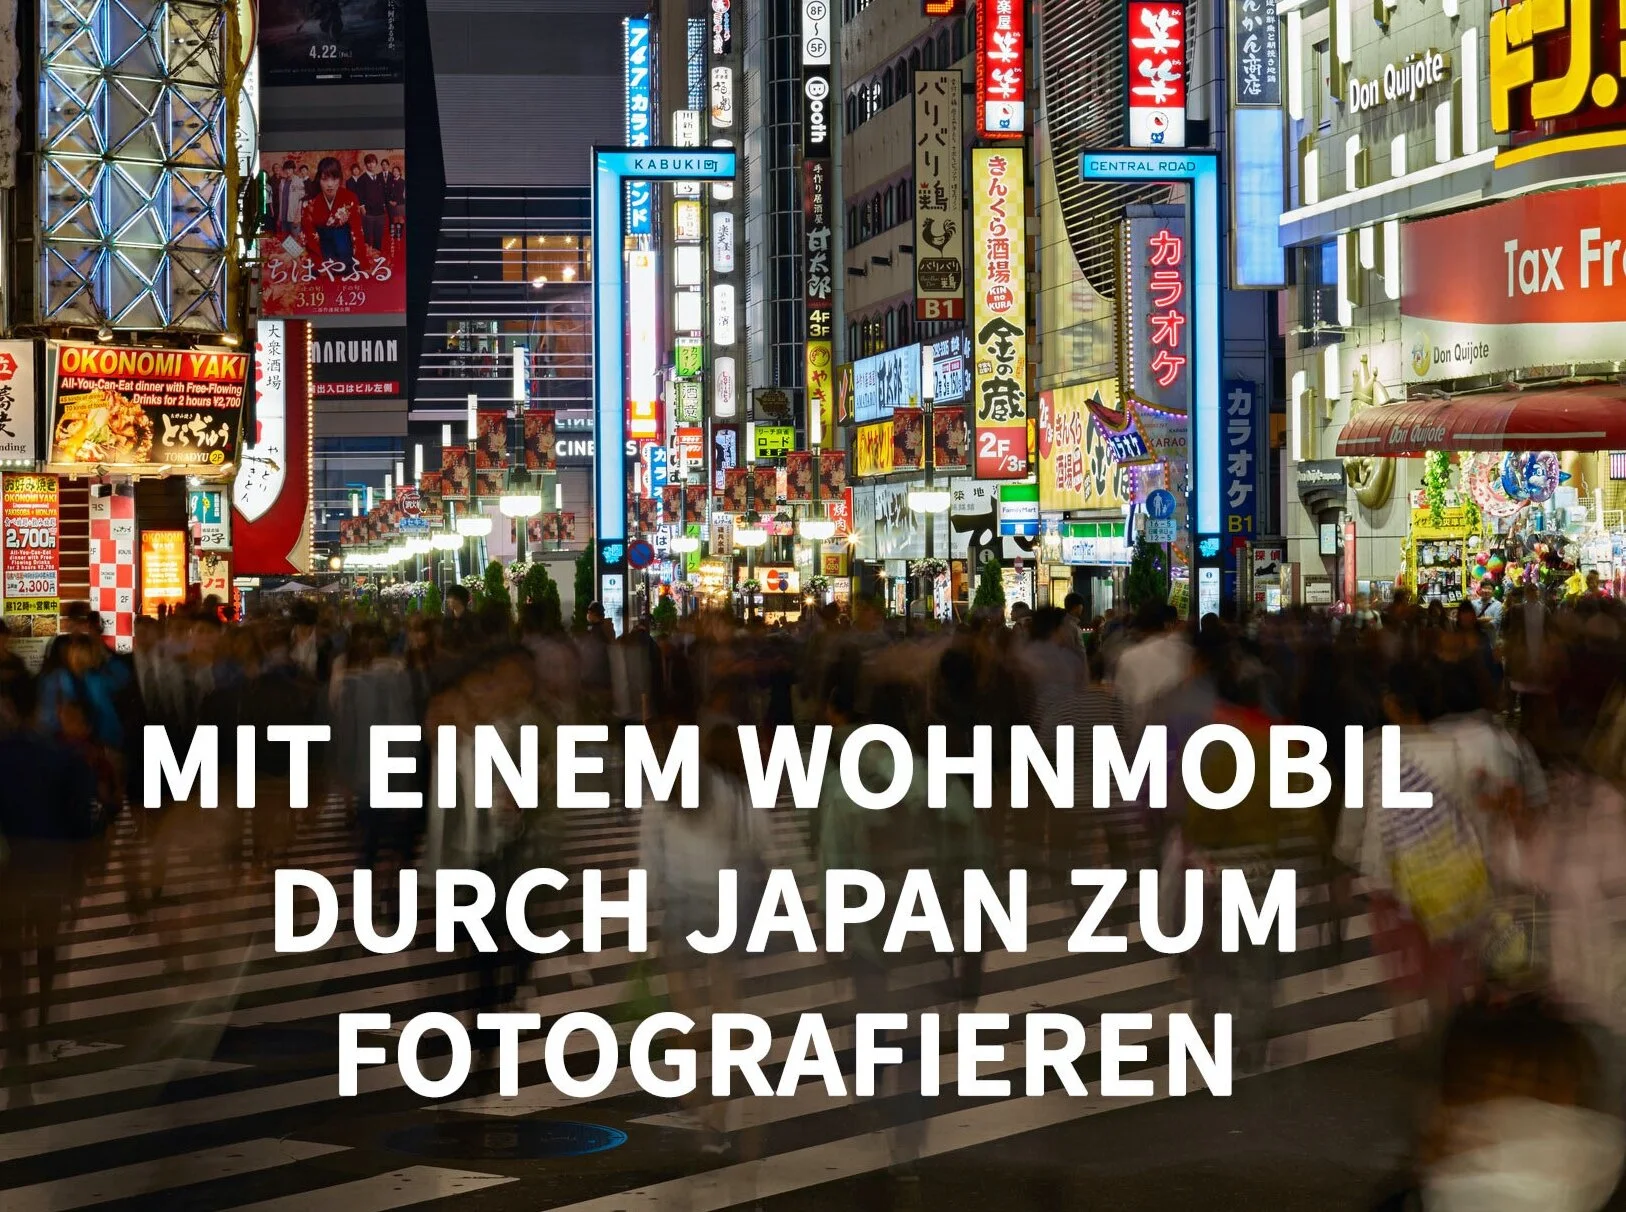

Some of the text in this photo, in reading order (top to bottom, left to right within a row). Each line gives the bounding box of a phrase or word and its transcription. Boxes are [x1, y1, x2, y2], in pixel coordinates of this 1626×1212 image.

[811, 6, 823, 15] 8F
[309, 45, 337, 59] 4.22
[630, 27, 649, 87] 747
[811, 43, 823, 53] 5F
[1132, 8, 1181, 104] 笑笑
[987, 31, 1020, 99] 笑笑
[1350, 49, 1443, 114] Don Quijote
[631, 94, 649, 228] カラオンド
[1090, 161, 1196, 171] CENTRAL ROAD
[987, 156, 1010, 284] きんくら酒場
[268, 257, 391, 283] ちはやふる
[806, 226, 832, 299] 甘太郎
[1504, 227, 1626, 297] Tax Fr
[297, 292, 366, 307] 3.19 4.29
[926, 300, 953, 318] B1
[989, 301, 1011, 309] KURA
[1150, 230, 1185, 386] カラオケ
[809, 309, 830, 322] 4F
[809, 324, 830, 337] 3F
[61, 347, 247, 380] OKONOMI YAKI
[266, 324, 282, 390] 大衆酒場
[1433, 341, 1489, 364] Don Quijote
[978, 317, 1025, 421] 金の蔵
[61, 377, 243, 396] All-You-Can-Eat dinner with Free-Flowing
[133, 393, 241, 409] Drinks for 2 hours ¥2,700
[1055, 411, 1082, 447] きんくら
[1389, 424, 1446, 447] Don Quijote
[758, 436, 790, 447] ロード
[1227, 388, 1253, 508] カラオケ
[165, 452, 222, 462] TORADYU 2F
[833, 503, 848, 531] 焼肉
[1228, 515, 1253, 533] B1
